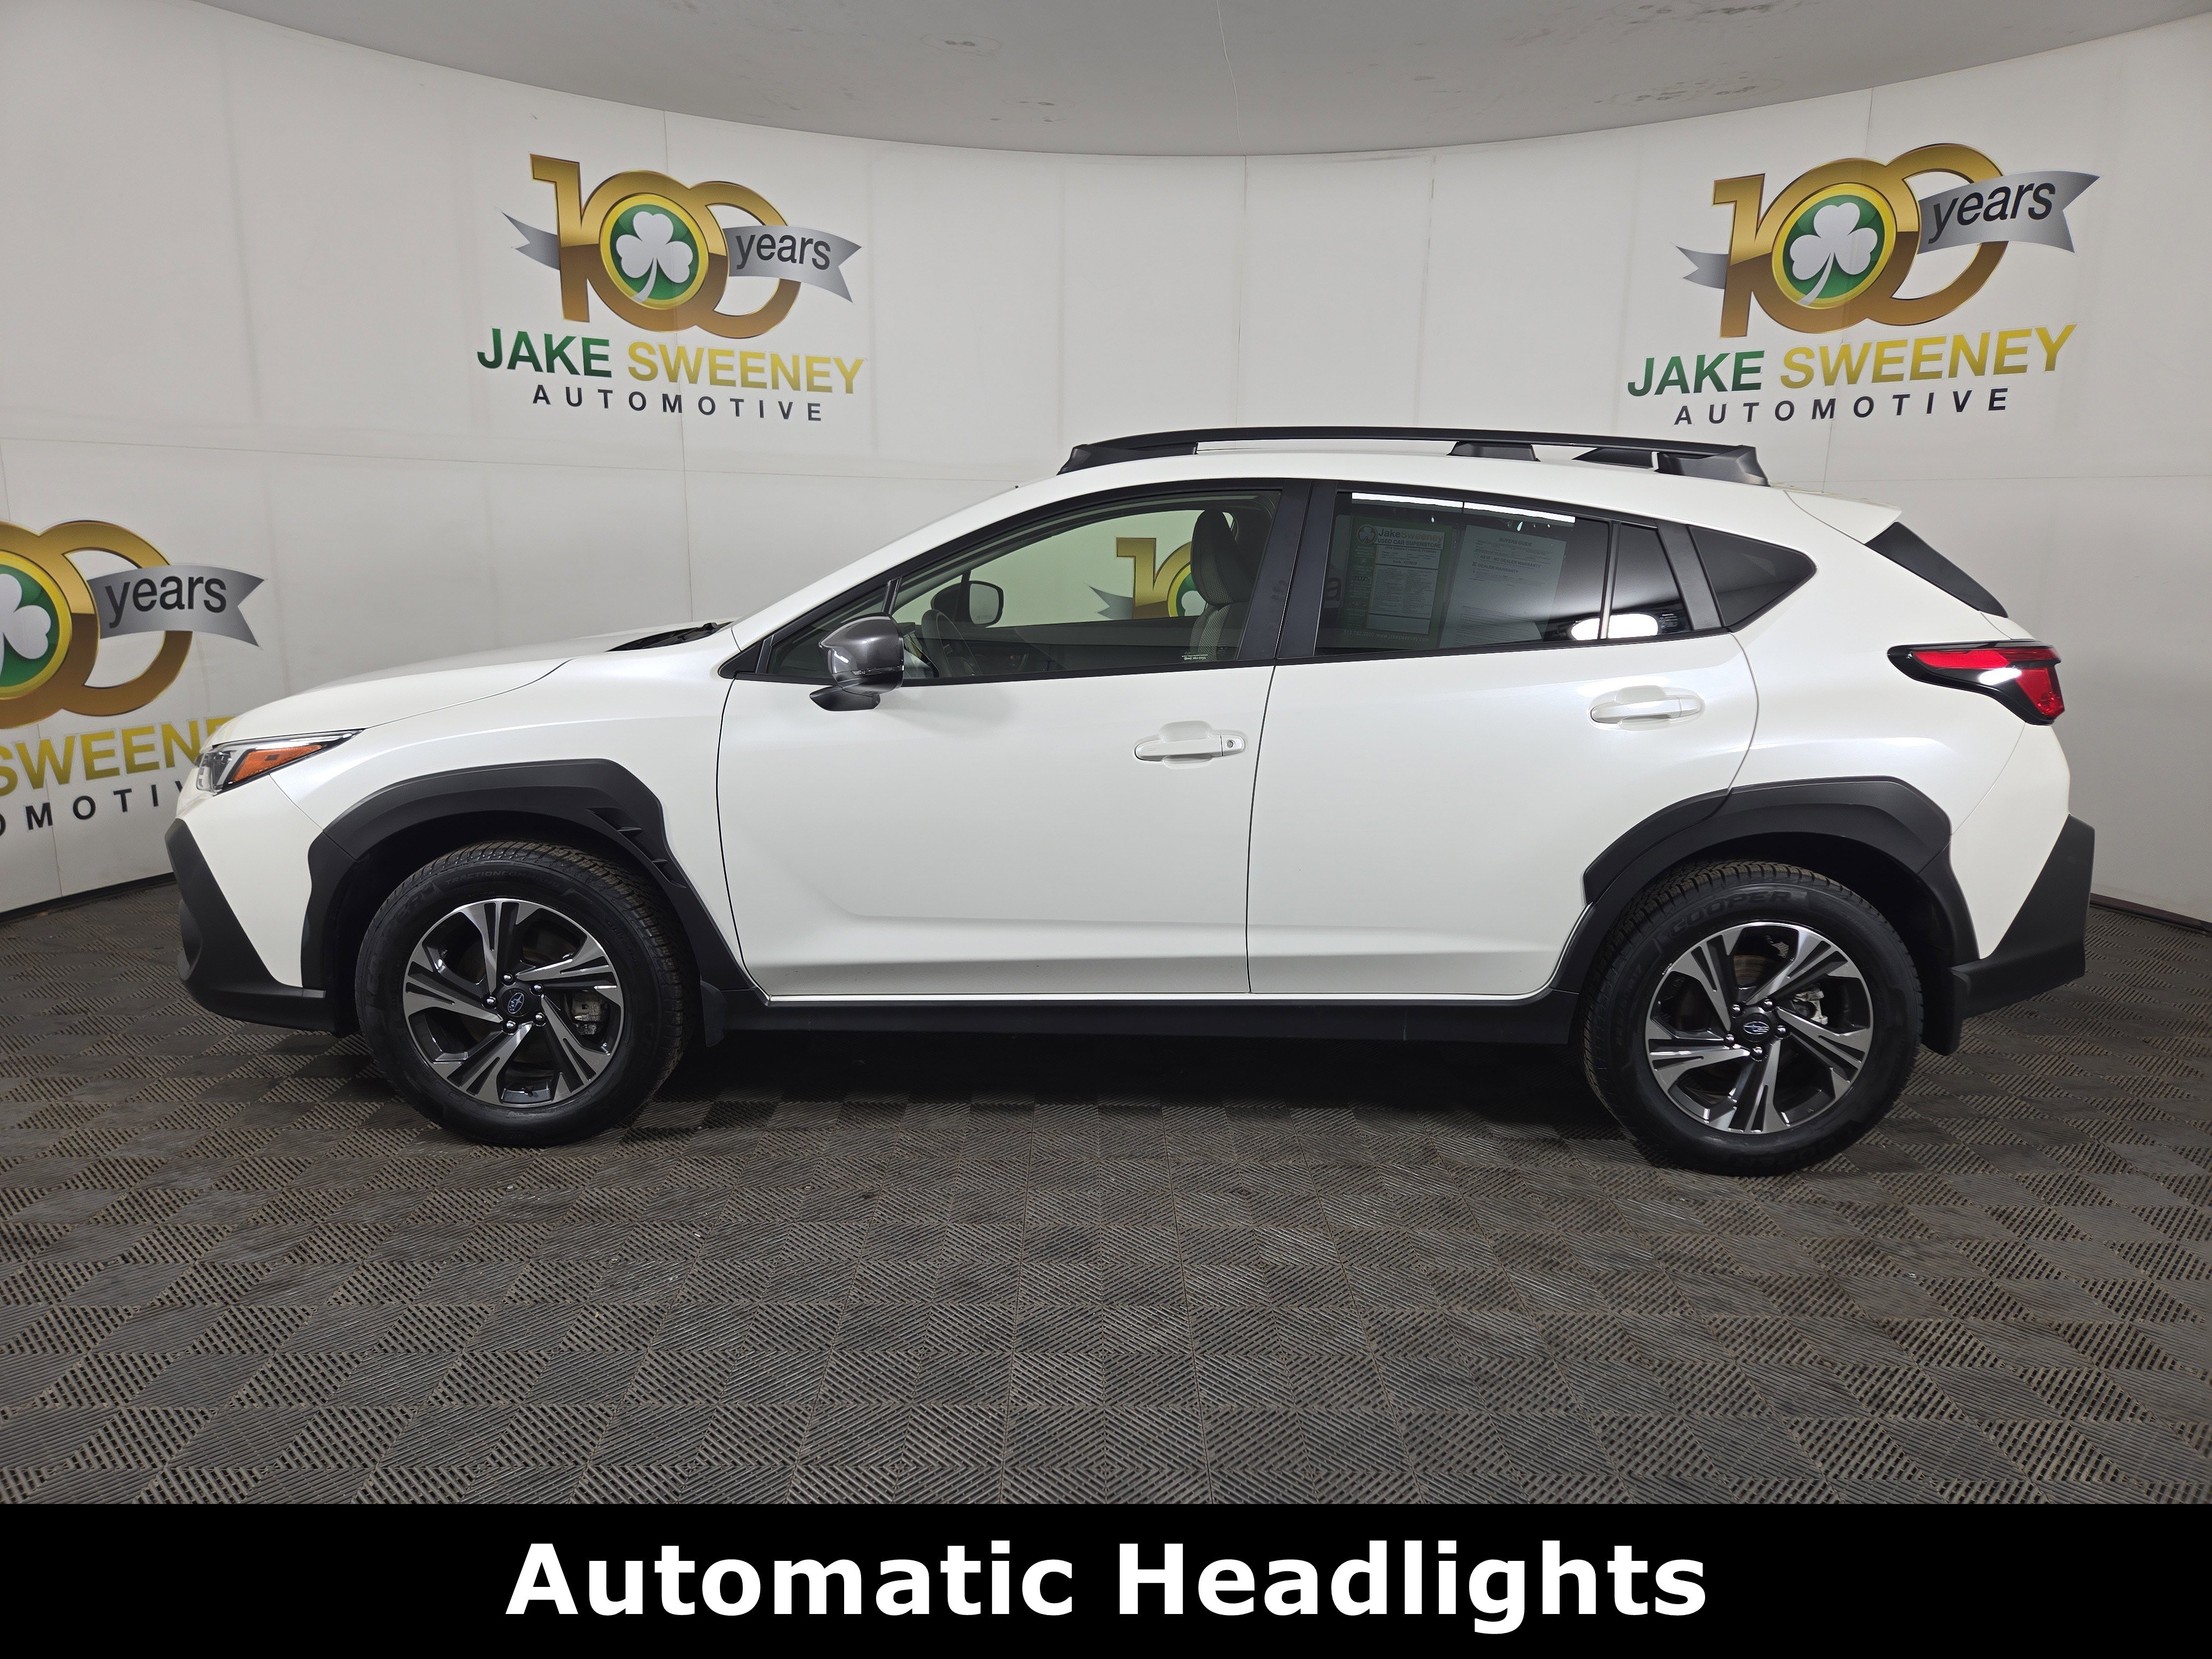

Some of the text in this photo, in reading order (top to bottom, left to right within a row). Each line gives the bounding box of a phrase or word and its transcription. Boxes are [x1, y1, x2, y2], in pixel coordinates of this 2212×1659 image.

[1712, 143, 2009, 338] 100
[1928, 180, 2056, 244] years
[530, 153, 801, 339] 100
[735, 233, 831, 271] years
[477, 328, 865, 394] JAKE SWEENEY
[1627, 324, 2078, 396] JAKE SWEENEY
[532, 384, 822, 421] AUTOMOTIVE
[1674, 388, 2009, 426] AUTOMOTIVE
[105, 575, 227, 628] years
